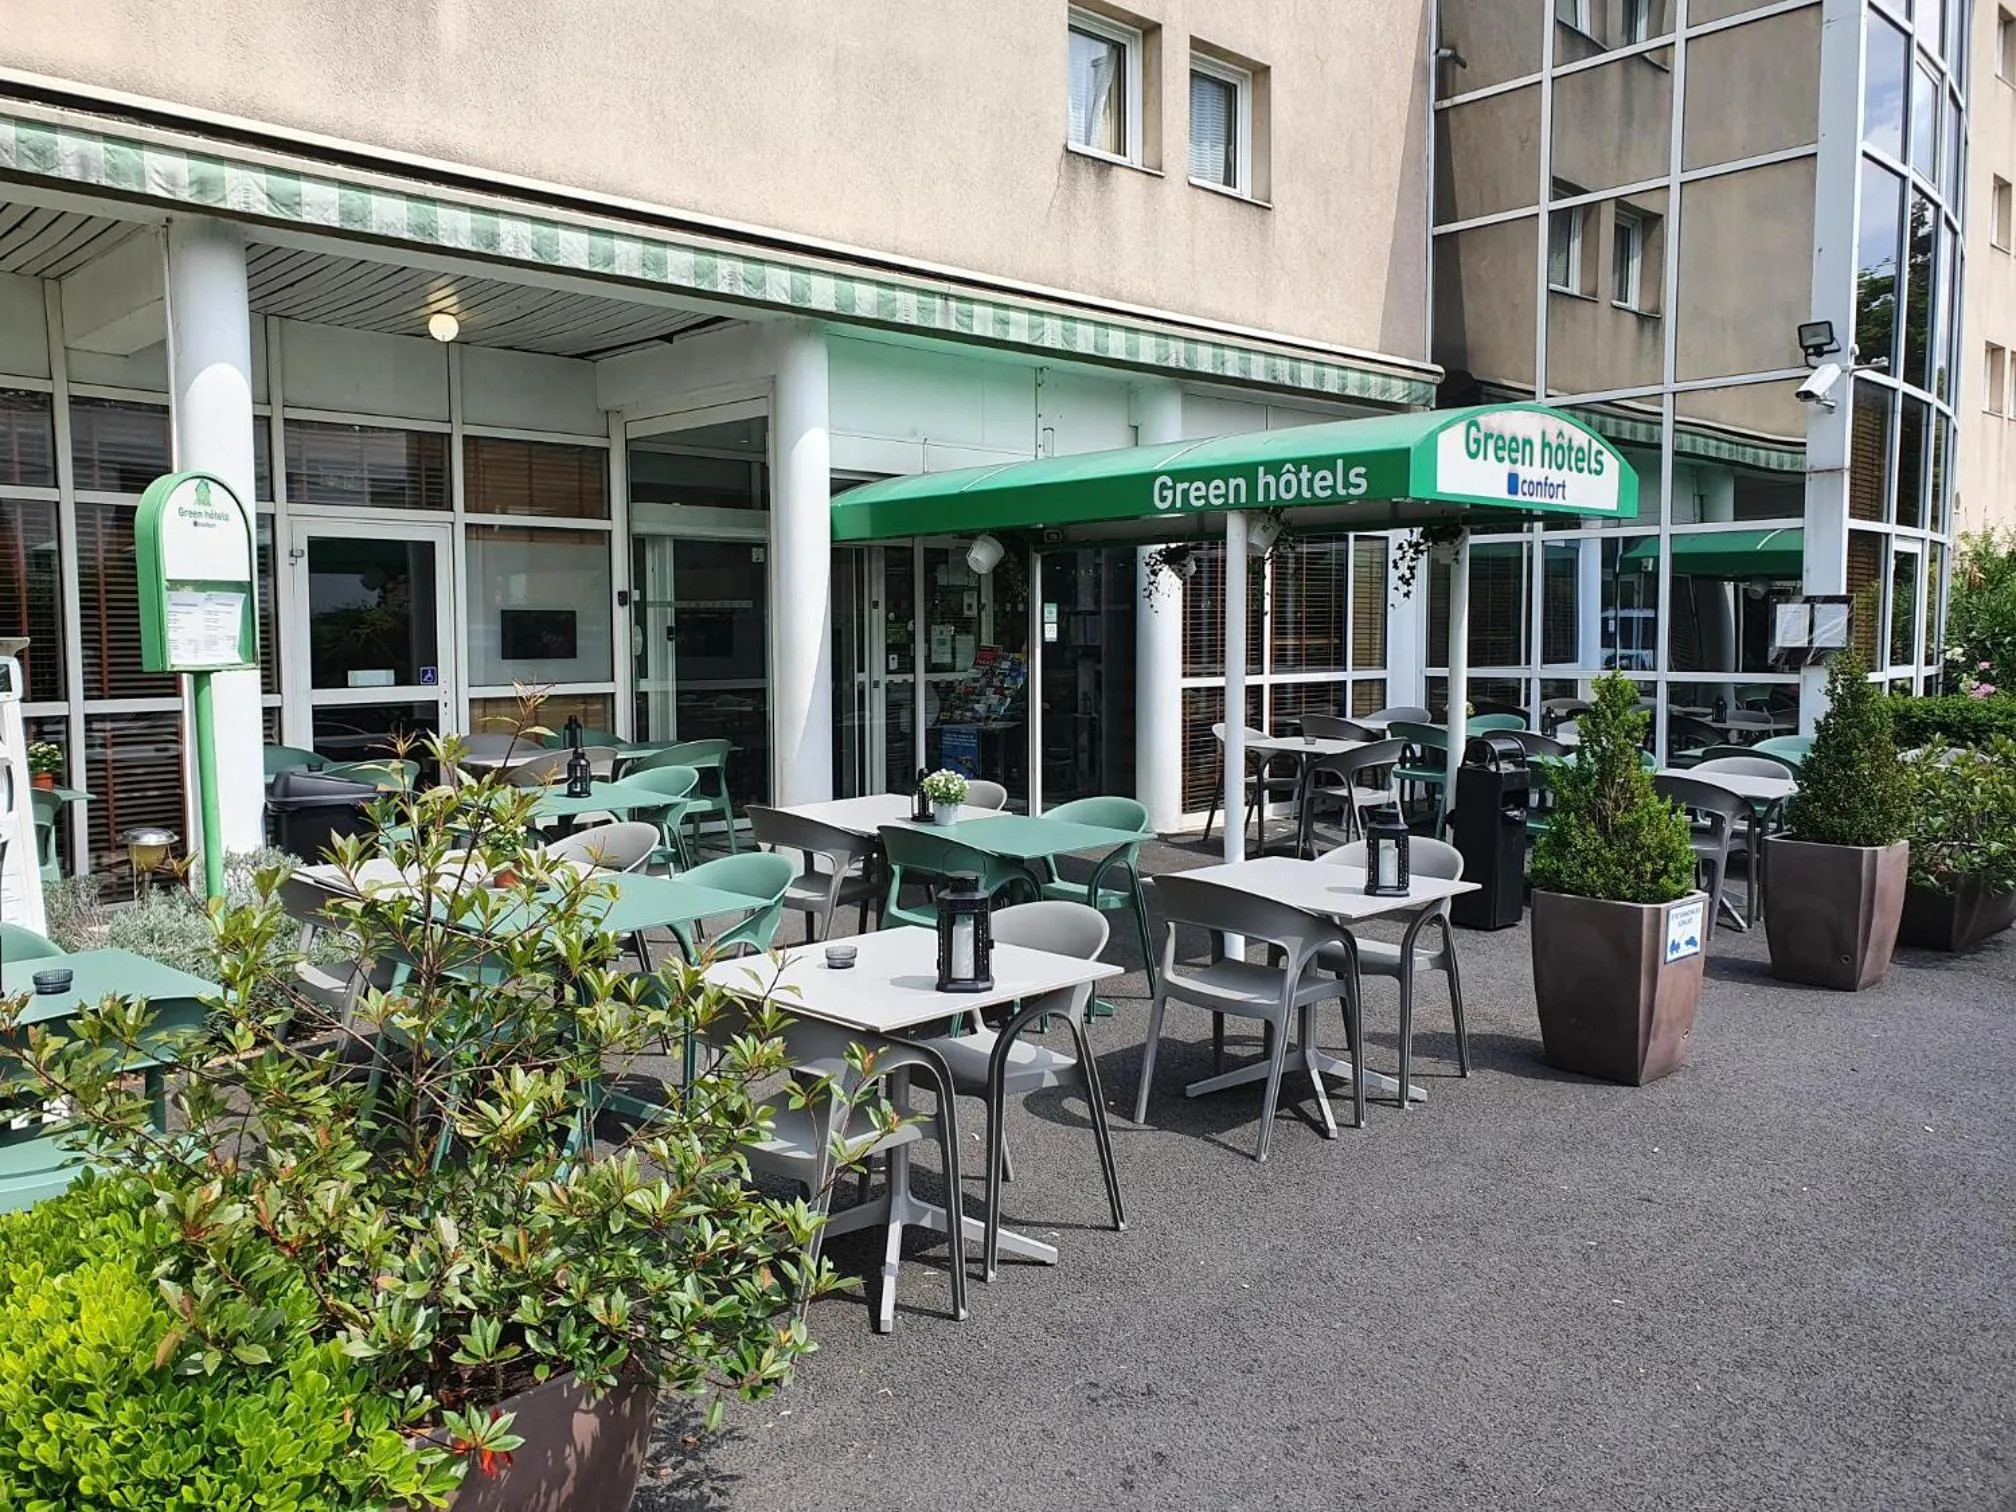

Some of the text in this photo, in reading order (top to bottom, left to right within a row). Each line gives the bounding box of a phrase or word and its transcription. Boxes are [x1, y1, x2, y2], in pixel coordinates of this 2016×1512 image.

[1465, 419, 1604, 476] Green hôtels
[1153, 459, 1368, 510] Green hôtels
[1520, 476, 1566, 500] confort
[178, 506, 203, 519] Green
